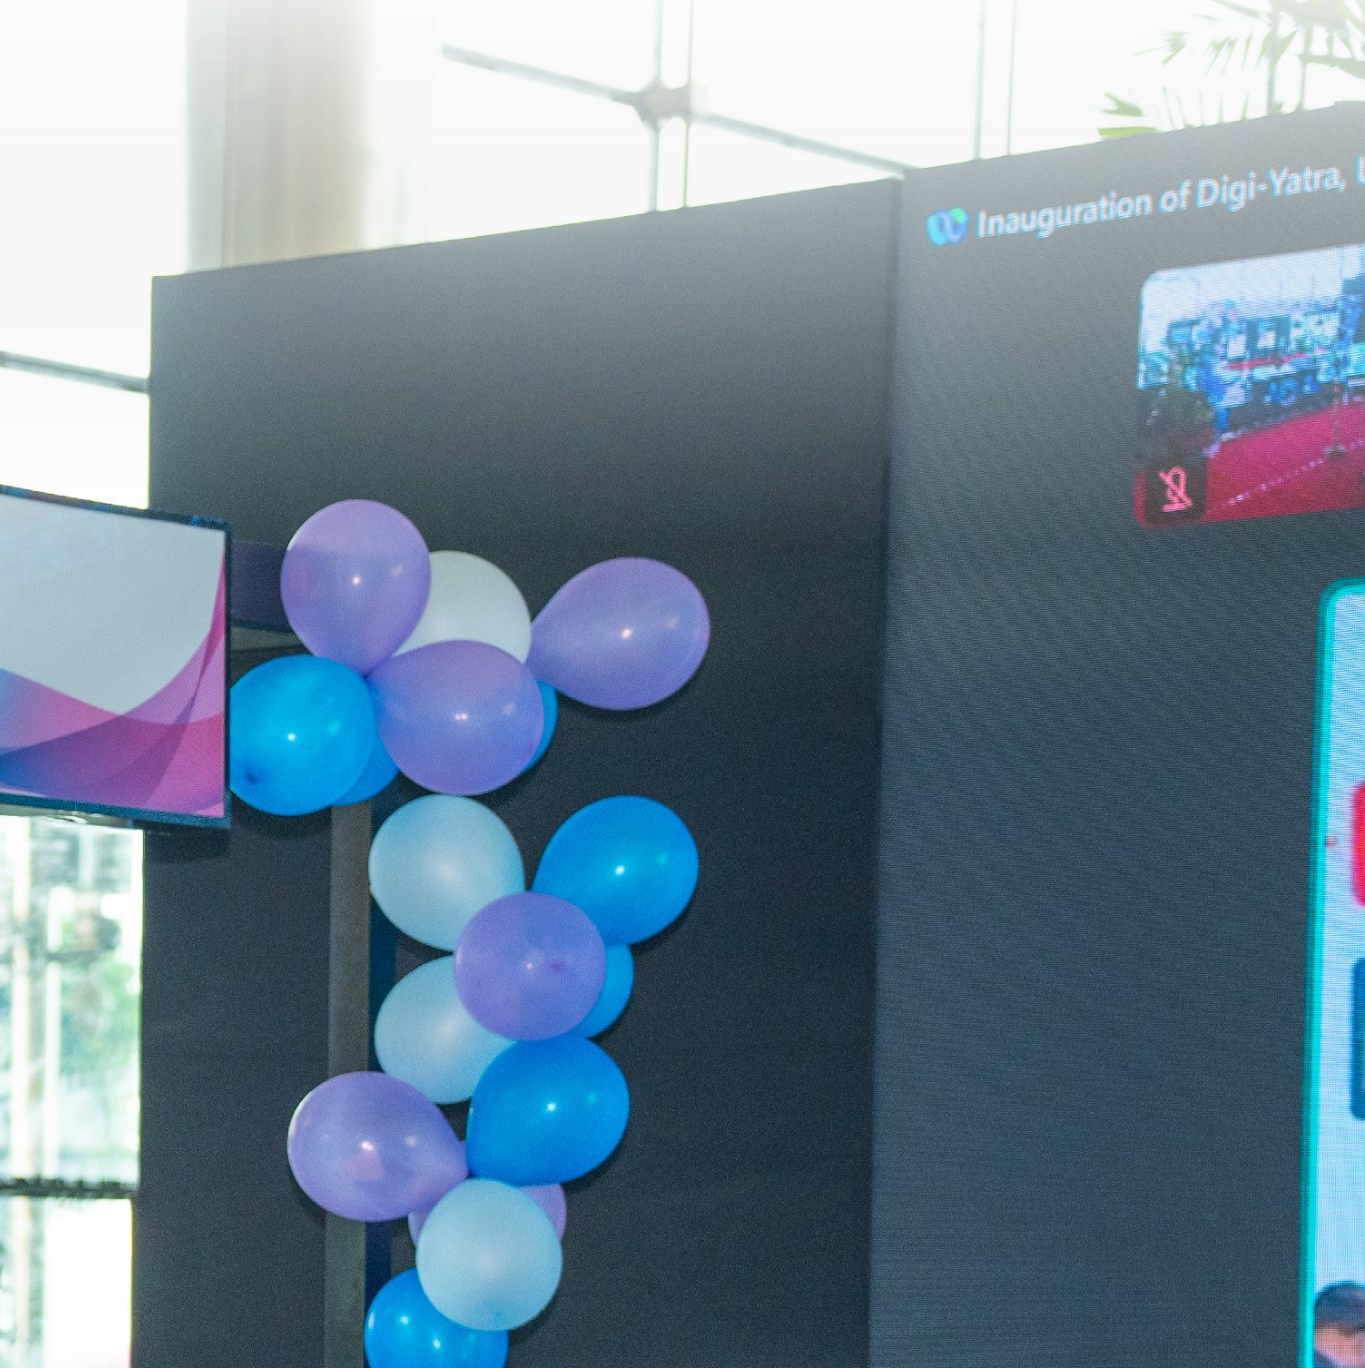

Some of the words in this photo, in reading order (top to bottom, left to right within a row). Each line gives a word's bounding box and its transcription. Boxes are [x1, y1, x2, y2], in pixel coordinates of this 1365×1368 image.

[975, 190, 1152, 240] Inauguration
[1159, 179, 1192, 213] of
[1197, 165, 1347, 213] Digi-Yatra,
